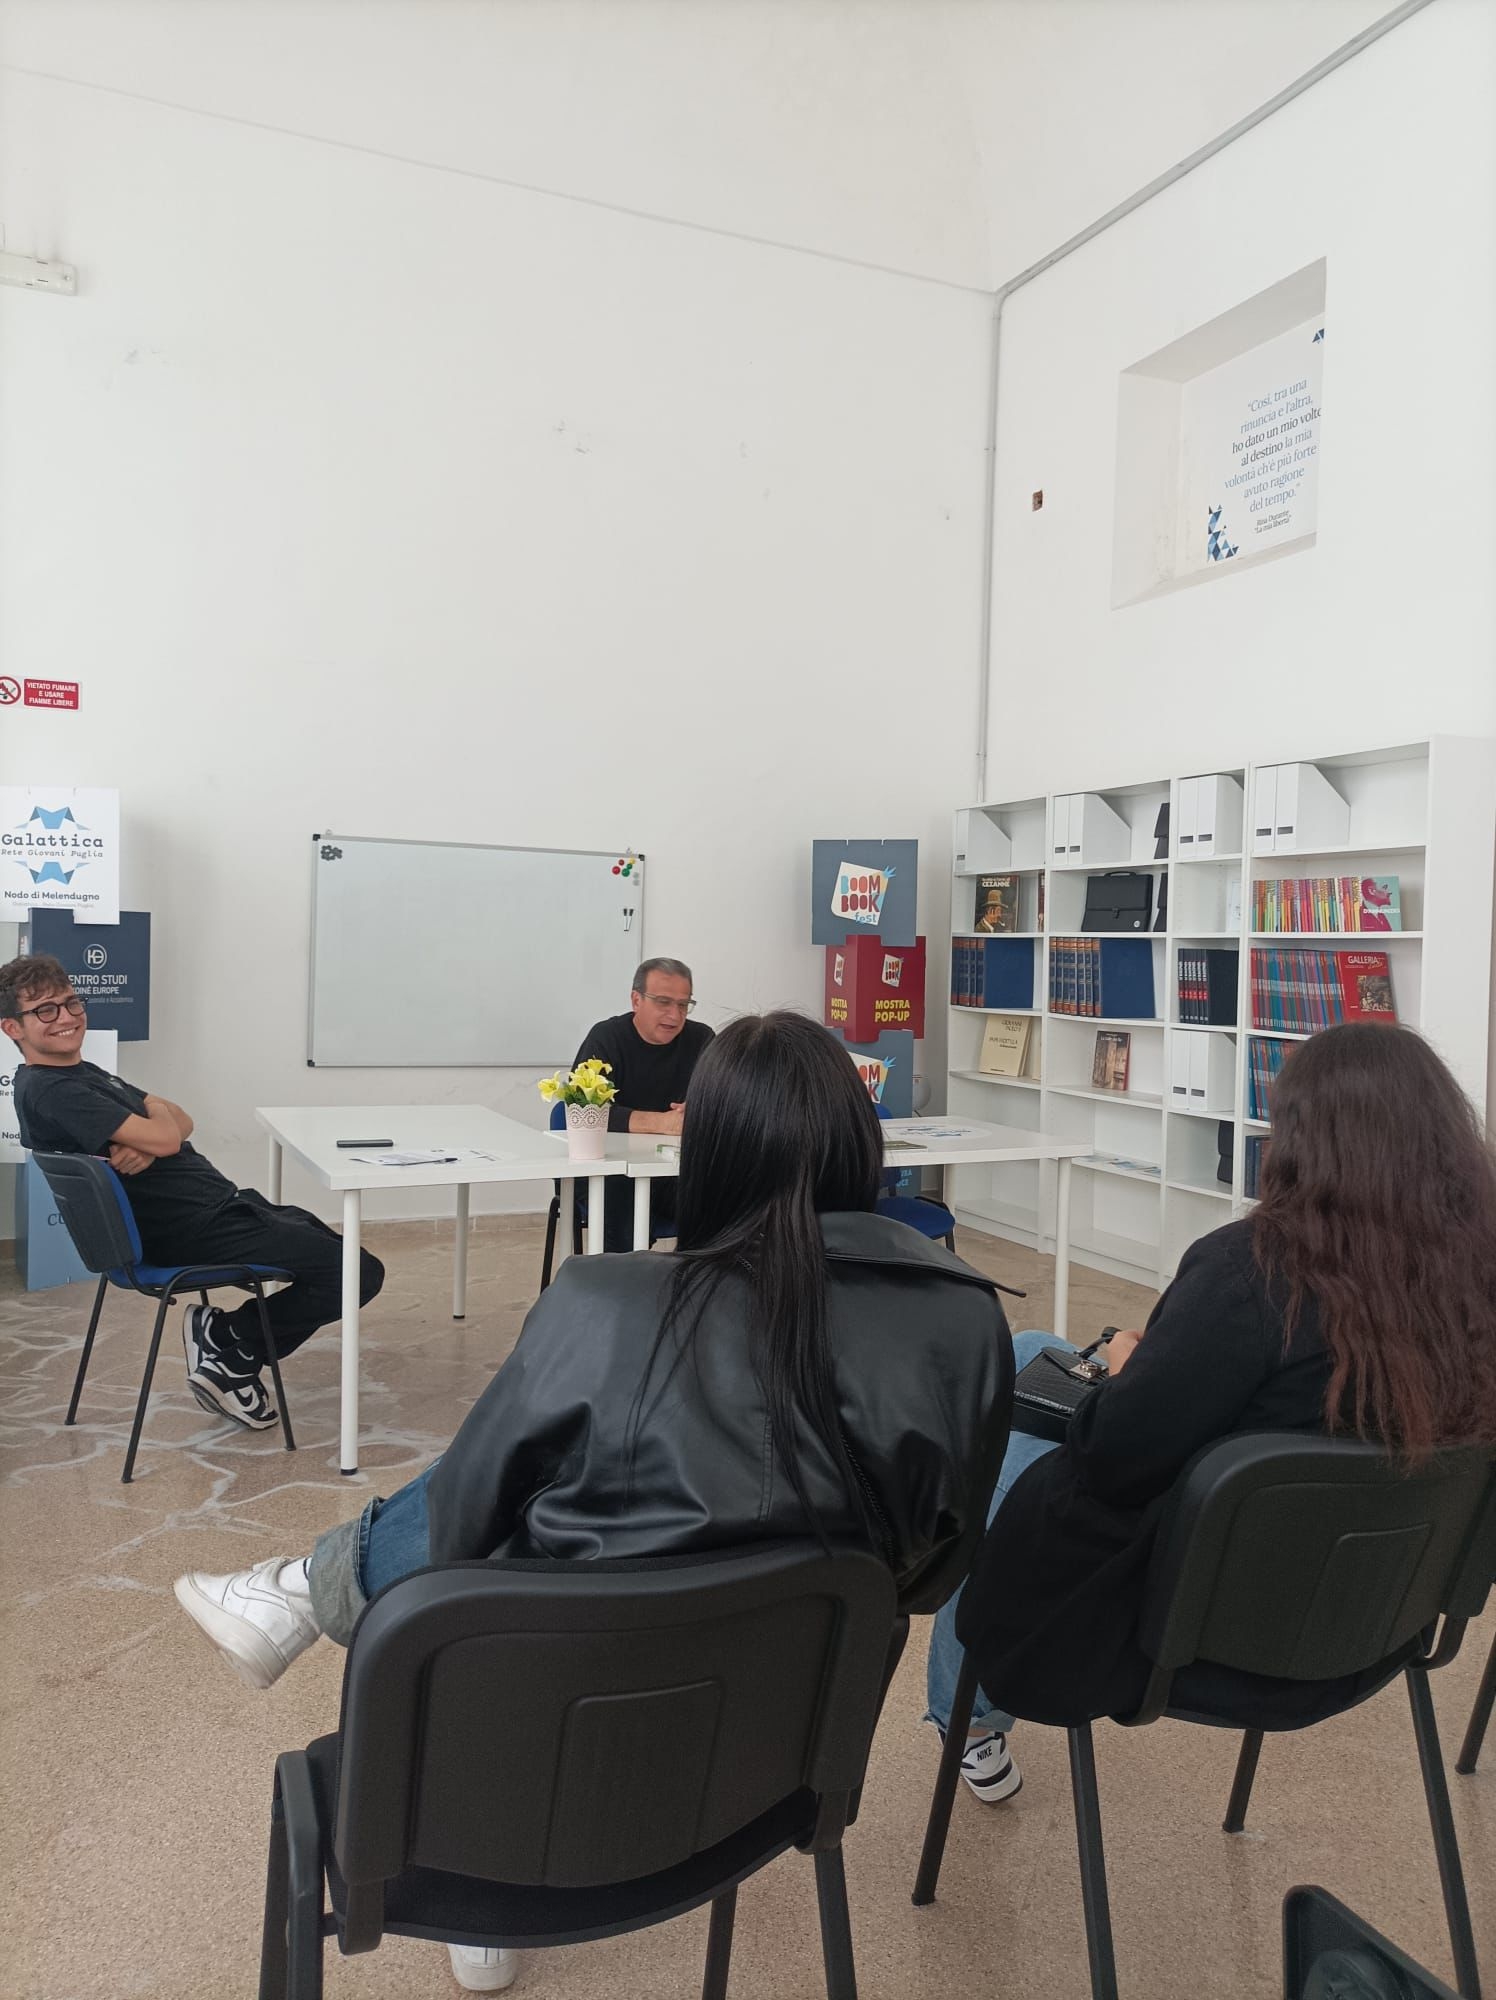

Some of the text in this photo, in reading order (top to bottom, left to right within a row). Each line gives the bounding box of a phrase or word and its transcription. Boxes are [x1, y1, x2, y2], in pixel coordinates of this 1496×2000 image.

[1274, 389, 1287, 402] tra
[1289, 380, 1307, 395] una
[1240, 410, 1276, 434] rinuncia
[1278, 407, 1284, 417] e
[1232, 442, 1244, 454] ho
[1245, 433, 1265, 448] dato
[1266, 426, 1279, 439] un
[1280, 417, 1298, 433] mio
[1241, 429, 1312, 467] al destino la mia
[1294, 445, 1317, 462] forte
[1244, 467, 1305, 498] avuto ragione
[1249, 496, 1263, 512] del
[27, 682, 76, 692] VIETATO FUMARE
[29, 697, 74, 707] FIAMME LIBERE
[1, 833, 104, 848] Galattica
[28, 849, 65, 857] Giovani
[71, 850, 103, 859] Puglia
[841, 875, 881, 894] BOOM
[4, 890, 100, 902] Nodo di Melendugno
[841, 894, 880, 912] BOOK
[855, 912, 877, 923] fest
[1347, 955, 1379, 965] GALLERIA
[68, 974, 128, 985] ENTRO STUDI
[93, 986, 120, 995] EUROPE
[875, 1000, 910, 1010] MOSTRA
[874, 1011, 910, 1022] POP-UP
[2, 1131, 21, 1140] Nod
[977, 1745, 993, 1761] NIKE
